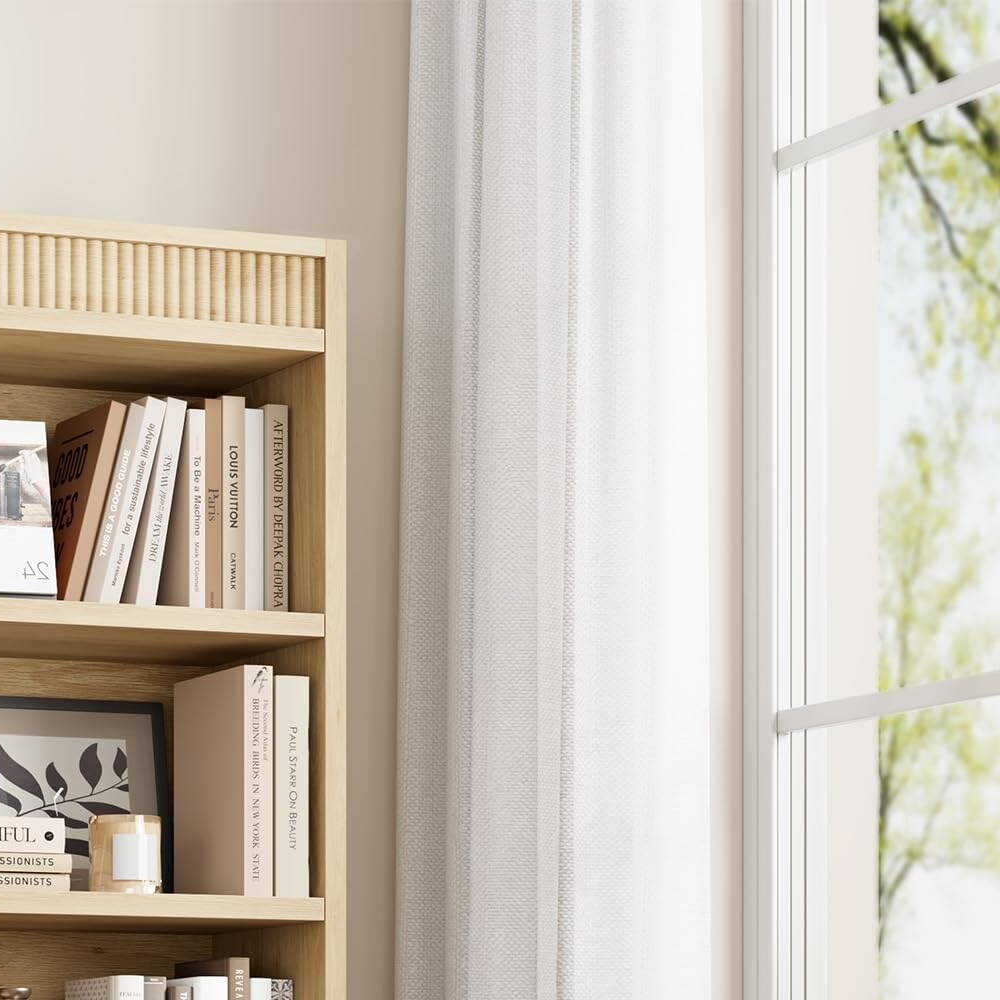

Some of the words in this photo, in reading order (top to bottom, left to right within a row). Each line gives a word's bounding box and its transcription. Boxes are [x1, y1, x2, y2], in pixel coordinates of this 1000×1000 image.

[118, 448, 131, 481] GUIDE
[193, 456, 201, 467] To
[229, 445, 239, 479] LOUIS
[273, 419, 284, 492] AFTERWORD
[122, 522, 132, 536] for
[128, 459, 147, 512] sustainable
[140, 423, 156, 459] lifestyle
[193, 470, 201, 483] Be
[110, 482, 123, 512] GOOD
[148, 523, 161, 562] DREAM
[160, 453, 173, 490] AWAKE
[208, 488, 220, 522] Paris
[229, 481, 239, 528] VUITTON
[273, 496, 284, 511] BY
[105, 523, 114, 534] IS
[108, 514, 116, 522] A
[193, 495, 201, 536] Machine
[99, 535, 111, 557] THIS
[273, 514, 284, 558] DEEPAK
[273, 561, 284, 608] CHOPRA
[252, 698, 260, 746] BREEDING
[252, 751, 260, 780] BIRDS
[252, 783, 260, 793] IN
[252, 798, 260, 819] NEW
[252, 822, 260, 849] YORK
[252, 854, 260, 880] STATE
